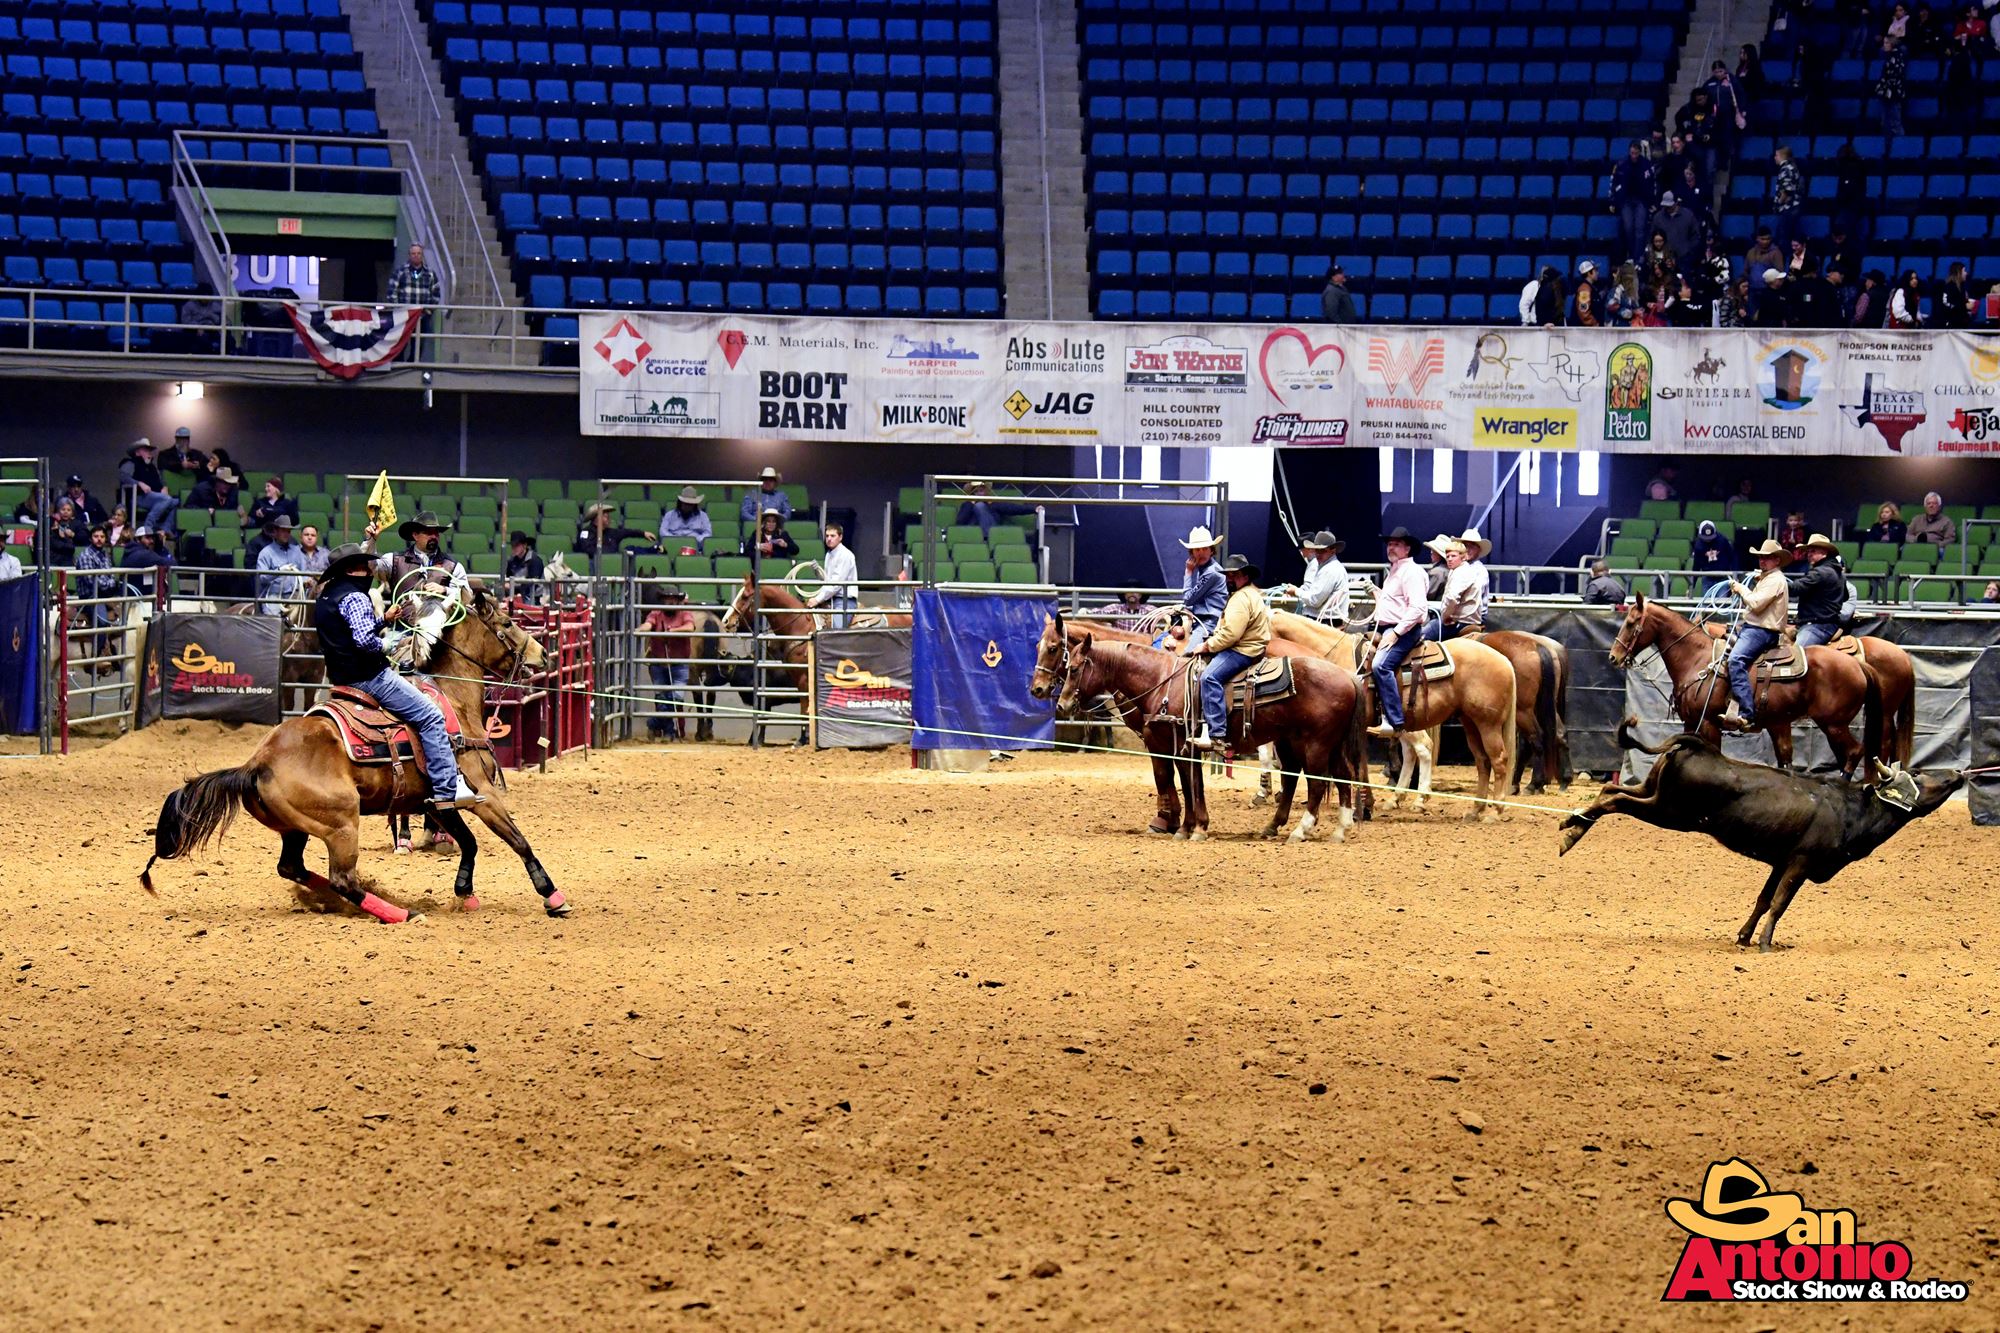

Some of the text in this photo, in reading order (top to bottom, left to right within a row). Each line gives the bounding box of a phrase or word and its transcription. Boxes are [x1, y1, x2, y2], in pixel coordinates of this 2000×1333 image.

[281, 220, 298, 232] EXIT
[779, 336, 849, 350] Materials,
[854, 338, 879, 350] Inc.
[1839, 342, 1933, 351] THOMPSON RANCHES
[1129, 350, 1244, 371] JON WAYNE
[1848, 354, 1894, 362] PEARSALL,
[645, 363, 707, 376] Concrete
[881, 367, 985, 376] Painting and Construction
[1005, 360, 1105, 373] Communications
[759, 370, 848, 400] BOOT
[1154, 373, 1219, 385] Service Company
[1467, 390, 1482, 399] and
[1934, 384, 1995, 396] CHICAGO
[1034, 392, 1095, 415] JAG
[1366, 397, 1444, 410] WHATABURGER
[1874, 393, 1914, 404] TEXAS
[1143, 404, 1222, 414] HILL COUNTRY
[1874, 403, 1914, 414] BUILT
[600, 414, 717, 426] TheCountryChurch.com
[758, 400, 848, 430] BARN
[1140, 418, 1223, 428] CONSOLIDATED
[1360, 420, 1393, 428] PRUSKI
[1431, 422, 1448, 430] INC
[1607, 411, 1647, 439] Pedro
[1372, 431, 1394, 439] (210)
[1481, 416, 1569, 443] Wrangler
[1684, 420, 1806, 439] kw COASTAL BEND
[1141, 432, 1222, 442] (210) 748-2609
[1938, 441, 1989, 453] Equipment
[192, 685, 215, 693] Stock
[216, 686, 237, 694] Show
[353, 746, 374, 757] CSI
